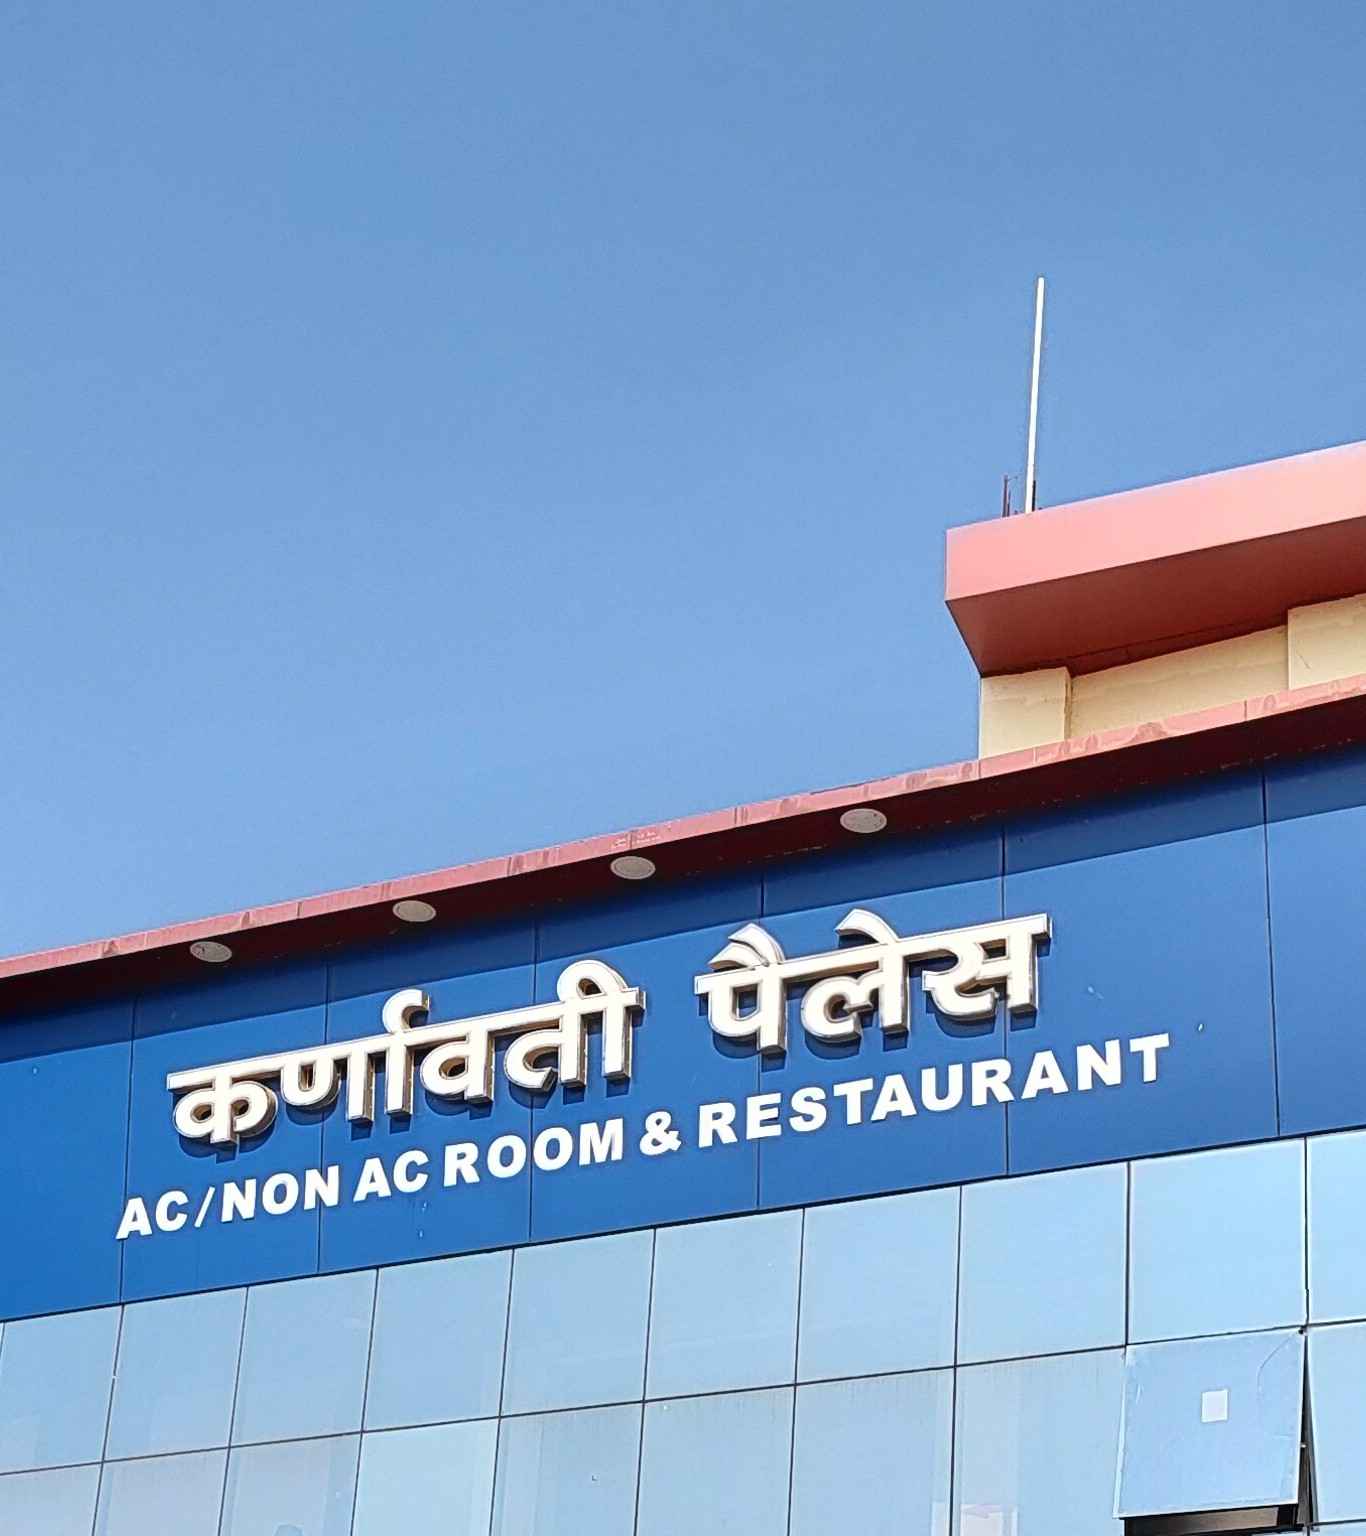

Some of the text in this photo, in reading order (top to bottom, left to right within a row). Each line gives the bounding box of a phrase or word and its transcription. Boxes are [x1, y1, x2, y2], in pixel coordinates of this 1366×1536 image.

[167, 908, 1053, 1145] कर्णावती पैलेस
[353, 1149, 430, 1203] AC
[443, 1117, 625, 1188] ROOM
[639, 1110, 683, 1156] &
[697, 1033, 1171, 1149] RESTAURANT
